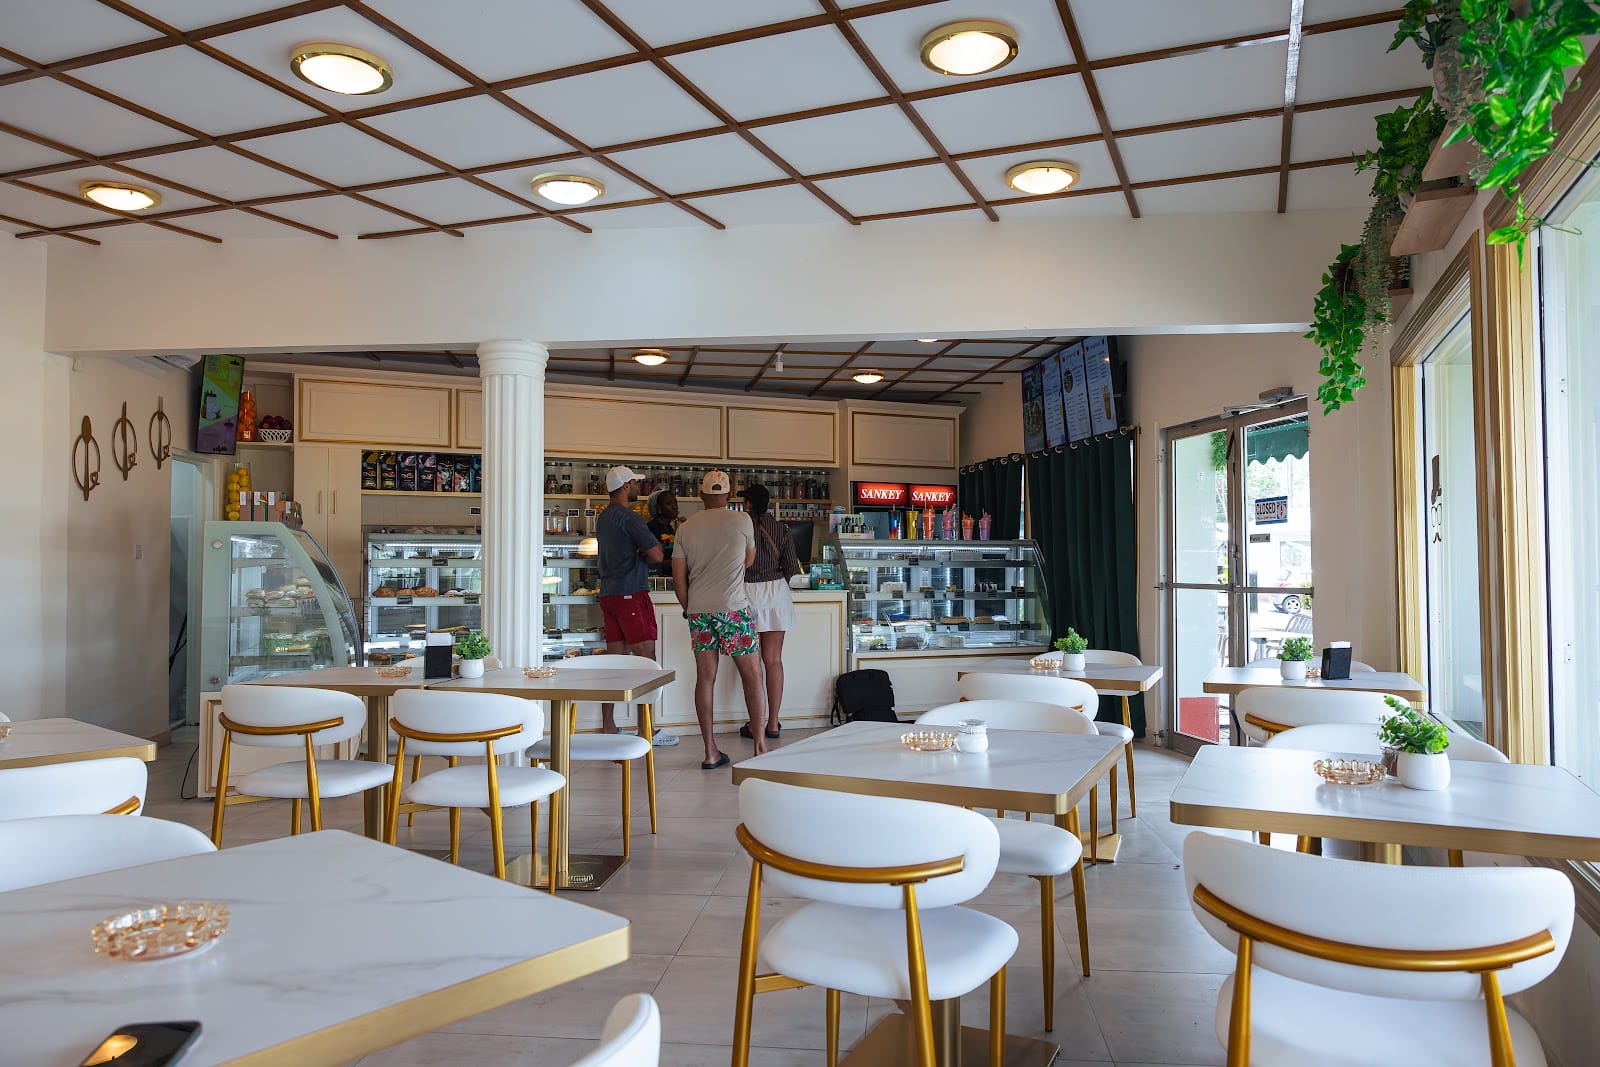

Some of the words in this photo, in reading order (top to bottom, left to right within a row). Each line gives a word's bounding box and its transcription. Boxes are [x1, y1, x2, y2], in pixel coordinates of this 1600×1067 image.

[860, 488, 903, 500] SANKEY
[912, 491, 952, 502] SANKEY
[1256, 502, 1276, 515] CLOSED
